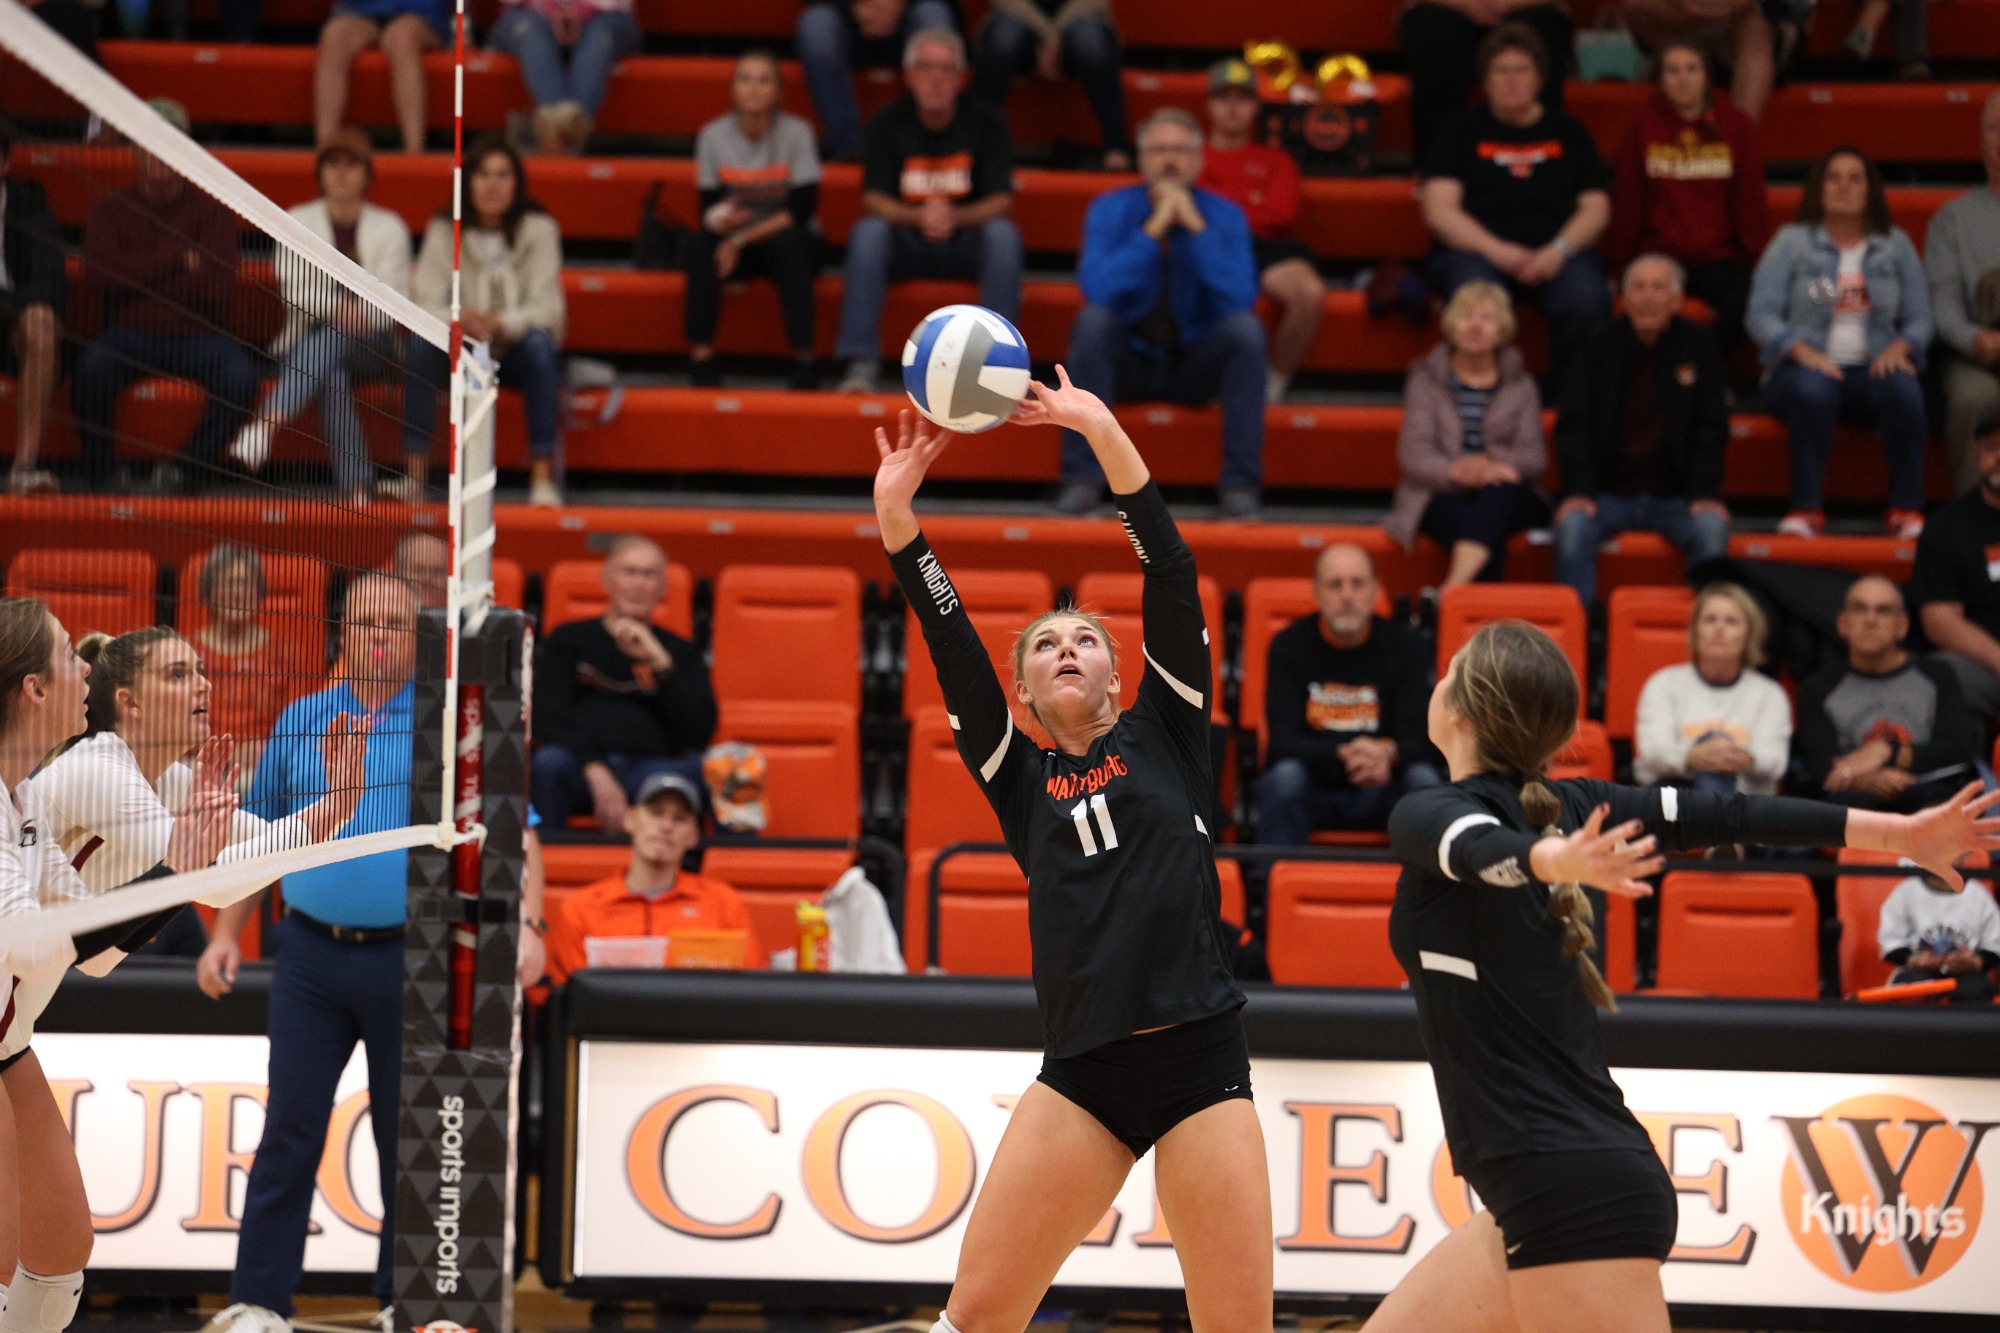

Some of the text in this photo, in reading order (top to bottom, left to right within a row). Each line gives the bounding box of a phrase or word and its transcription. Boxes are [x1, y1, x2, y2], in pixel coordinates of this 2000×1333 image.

[918, 549, 959, 616] KNIGHTS
[1046, 754, 1128, 801] WARTBURG
[1070, 793, 1119, 857] 11
[433, 1094, 466, 1294] sports imports
[625, 1083, 1757, 1265] COEE
[1800, 1190, 1966, 1246] Knights
